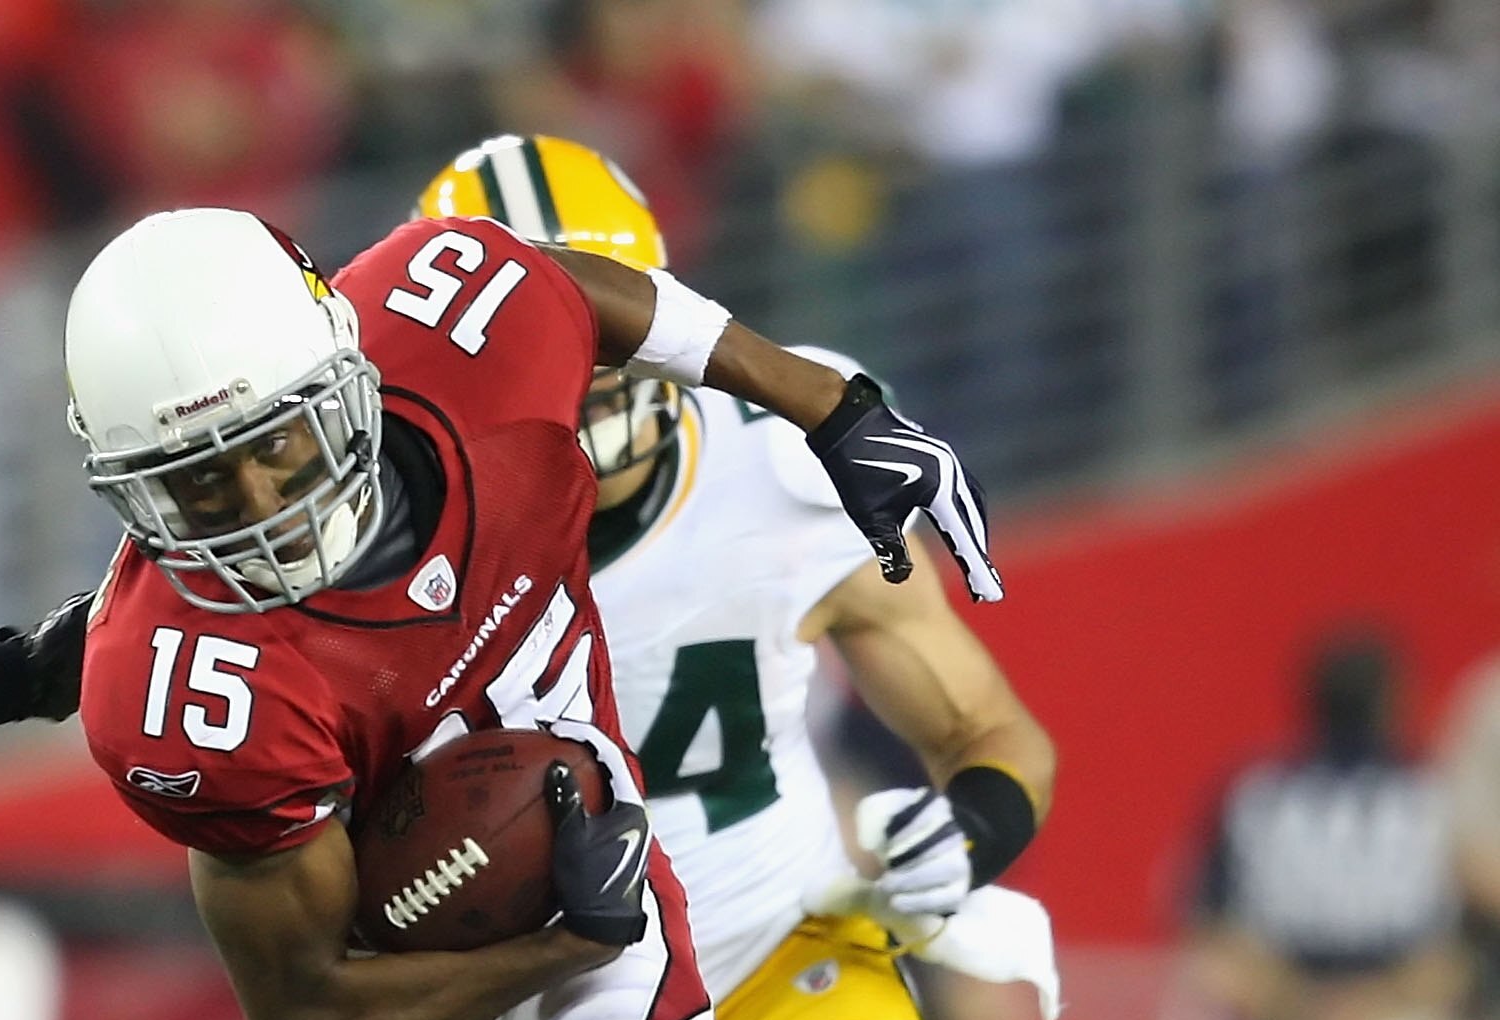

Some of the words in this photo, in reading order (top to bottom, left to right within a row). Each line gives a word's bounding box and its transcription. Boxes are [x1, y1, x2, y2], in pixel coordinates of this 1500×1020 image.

[384, 229, 529, 358] 15
[174, 387, 230, 418] Riddell
[142, 626, 261, 752] 15
[426, 574, 533, 708] CARDINALS
[635, 638, 781, 835] 4
